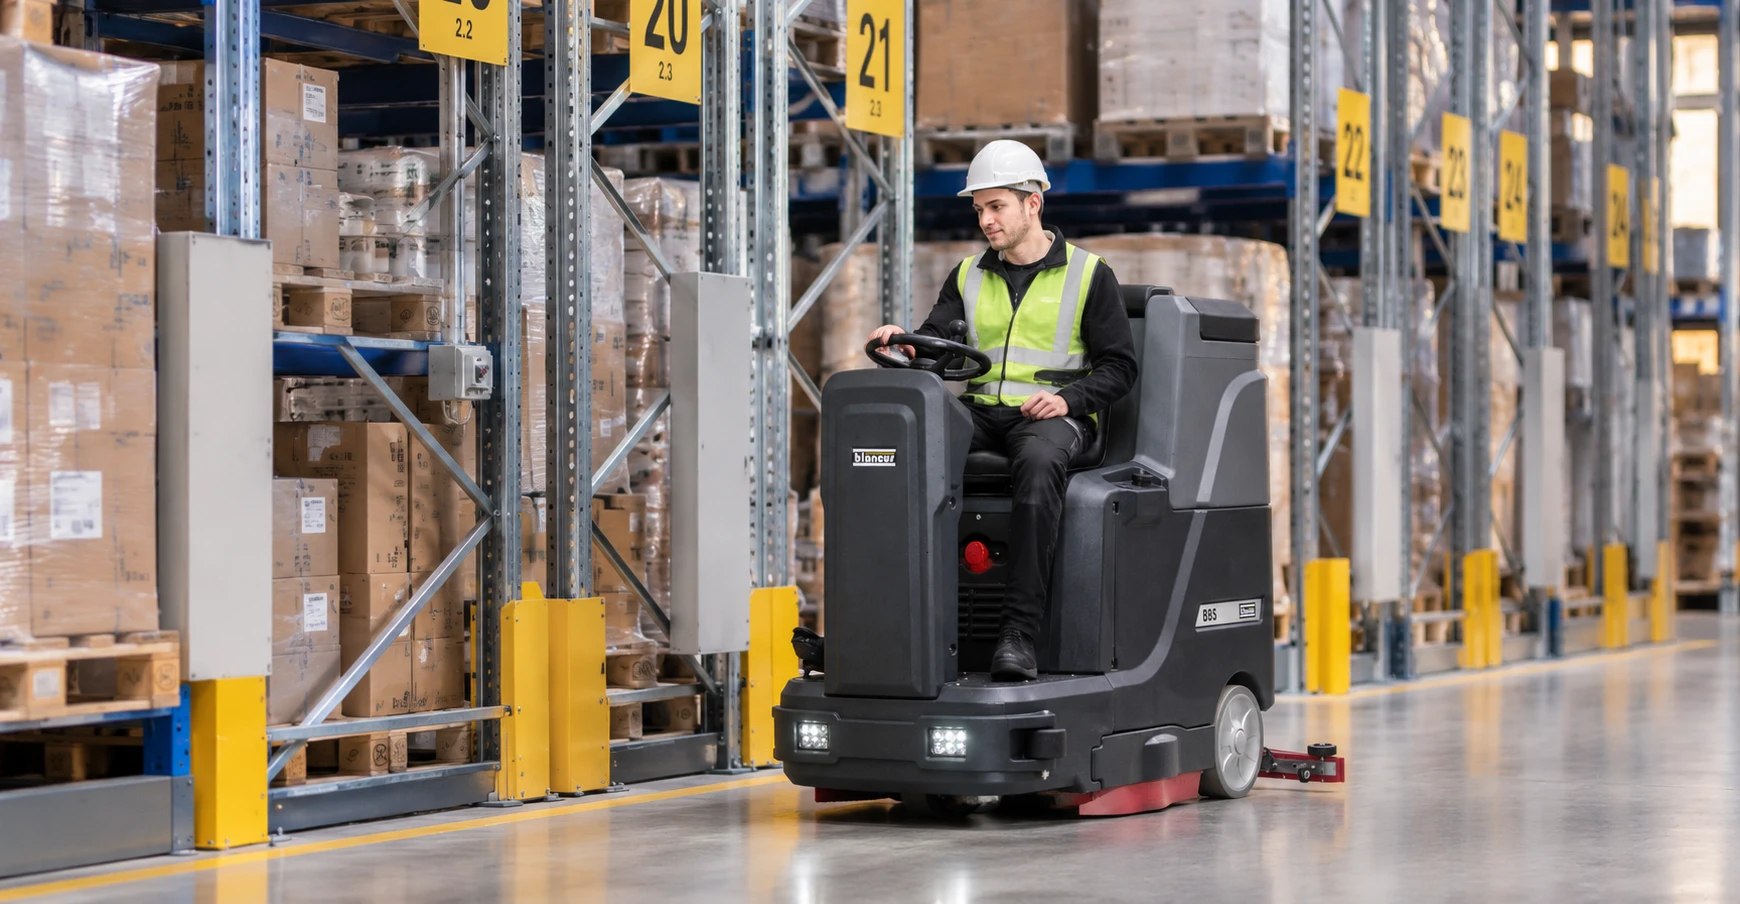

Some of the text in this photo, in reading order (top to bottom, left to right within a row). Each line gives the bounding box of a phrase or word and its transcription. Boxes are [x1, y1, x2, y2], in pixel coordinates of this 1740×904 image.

[455, 17, 473, 40] 2.2
[644, 0, 688, 55] 20
[859, 12, 890, 92] 21
[658, 60, 673, 81] 2.3
[1343, 121, 1364, 181] 22
[1448, 144, 1467, 200] 23
[1505, 158, 1523, 213] 24
